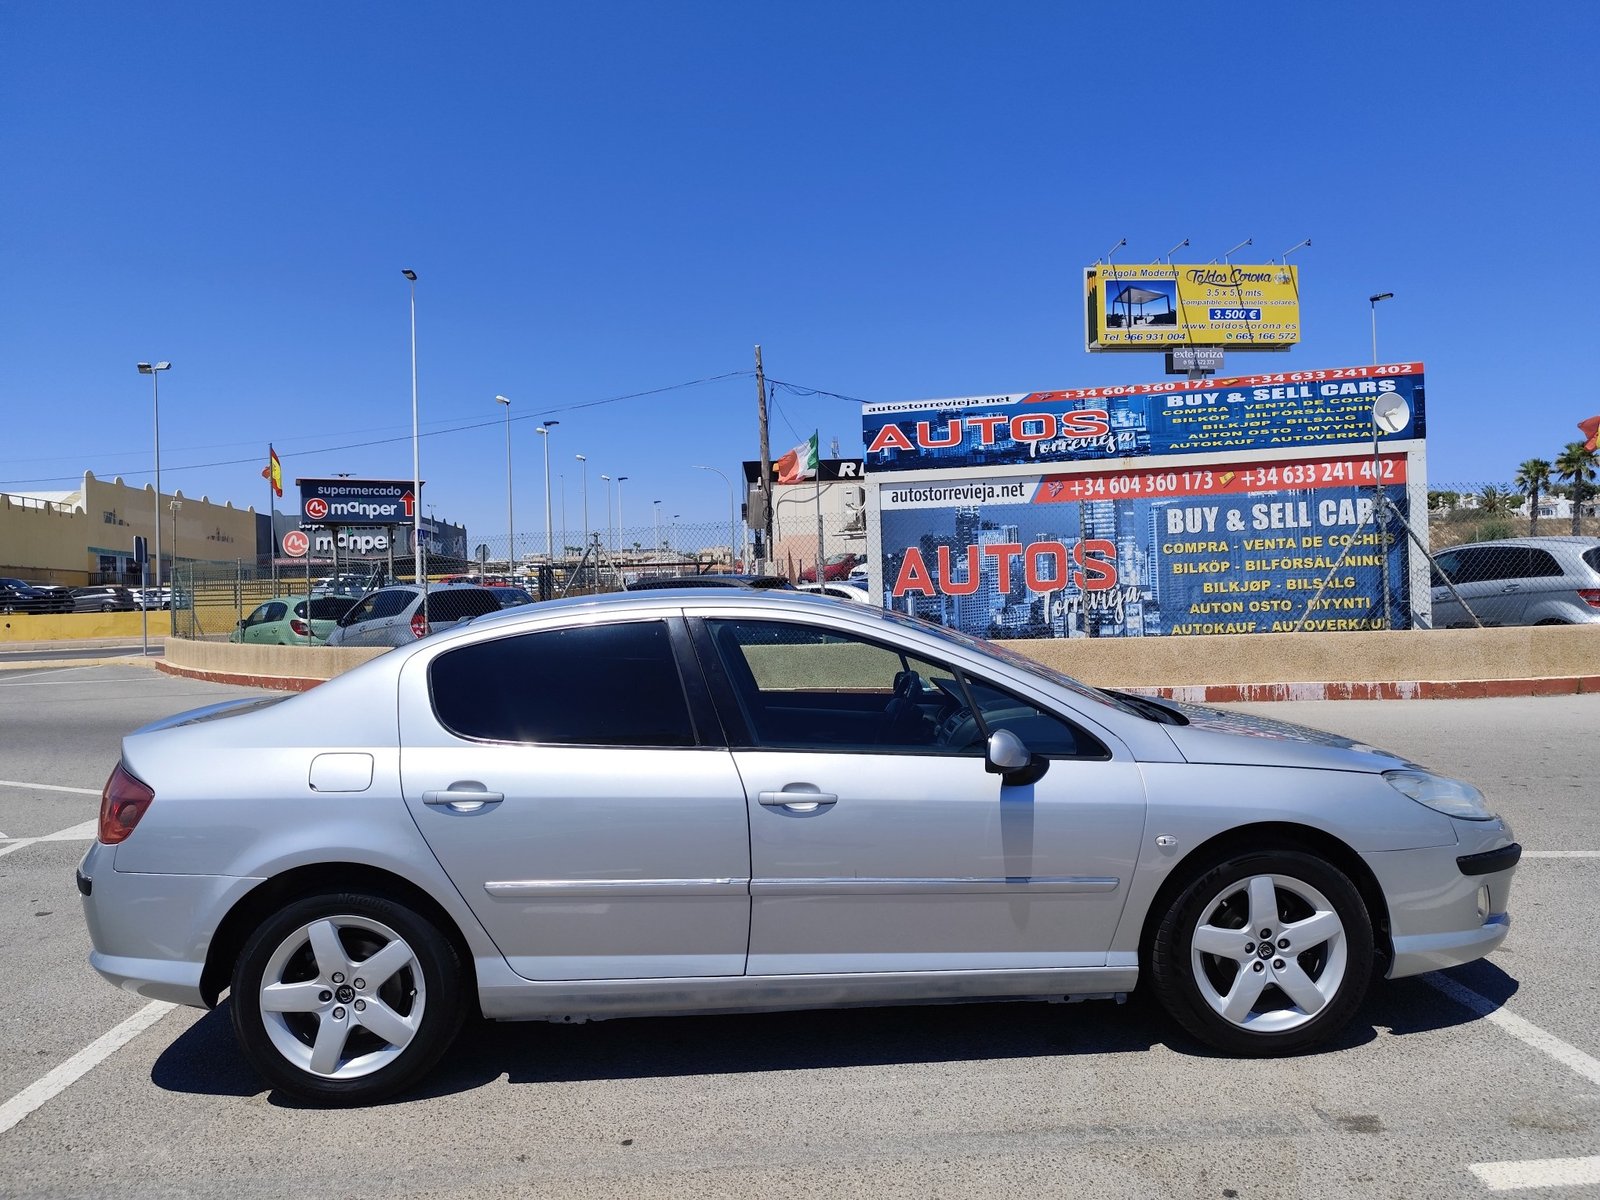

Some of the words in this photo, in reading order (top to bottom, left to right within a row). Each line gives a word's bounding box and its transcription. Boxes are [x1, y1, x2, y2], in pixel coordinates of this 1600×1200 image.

[1140, 269, 1180, 277] Moderna
[1186, 269, 1227, 285] Toldos
[1230, 268, 1271, 282] Corona
[1213, 310, 1247, 320] 3.500
[1249, 310, 1258, 319] €
[1182, 322, 1297, 330] www.toldoscorona.es
[1124, 333, 1143, 341] 966
[1146, 333, 1164, 341] 931
[1173, 350, 1224, 359] exterioriza
[868, 395, 1012, 413] autostorrevieja.net
[1060, 388, 1098, 399] +34
[1102, 385, 1136, 396] 604
[1141, 382, 1175, 393] 360
[1181, 379, 1215, 390] 173
[1246, 373, 1286, 385] +34
[1291, 370, 1326, 382] 633
[1333, 367, 1368, 379] 241
[1375, 364, 1412, 375] 402
[1167, 392, 1220, 408] BUY
[1227, 392, 1246, 403] &
[1253, 386, 1313, 402] SELL
[1321, 380, 1396, 396] CARS
[1162, 406, 1229, 416] COMPRA
[1244, 401, 1297, 411] VENTA
[1330, 396, 1377, 404] COCH
[1172, 412, 1230, 424] BILKÖP
[1245, 404, 1373, 419] BILFÖRSÄLJNIN
[1286, 415, 1356, 425] BILSALG
[867, 409, 1110, 453] AUTOS
[1188, 431, 1242, 440] AUTON
[1248, 428, 1292, 436] OSTO
[1307, 422, 1372, 432] MYYNTI
[1025, 431, 1135, 458] Torrevieja
[1169, 439, 1255, 449] AUTOKAUF
[891, 481, 1025, 502] autostorrevieja.net
[1070, 478, 1105, 496] +34
[1109, 475, 1141, 494] 604
[1145, 473, 1177, 492] 360
[1182, 471, 1213, 490] 173
[1241, 465, 1278, 486] +34
[1283, 464, 1316, 484] 633
[1321, 462, 1354, 481] 241
[1360, 459, 1394, 479] 402
[318, 486, 401, 496] supermercado
[331, 502, 397, 519] manper
[1167, 506, 1219, 534] BUY
[1226, 509, 1246, 532] &
[1252, 501, 1311, 530] SELL
[1319, 498, 1374, 526] CAR
[1162, 541, 1229, 555] COMPRA
[1243, 537, 1296, 551] VENTA
[1302, 536, 1322, 548] DE
[892, 539, 1118, 598] AUTOS
[1173, 560, 1231, 574] BILKÖP
[1203, 580, 1271, 594] BILKJØP
[1190, 602, 1244, 615] AUTON
[1249, 600, 1292, 613] OSTO
[1171, 622, 1257, 636] AUTOKAUF
